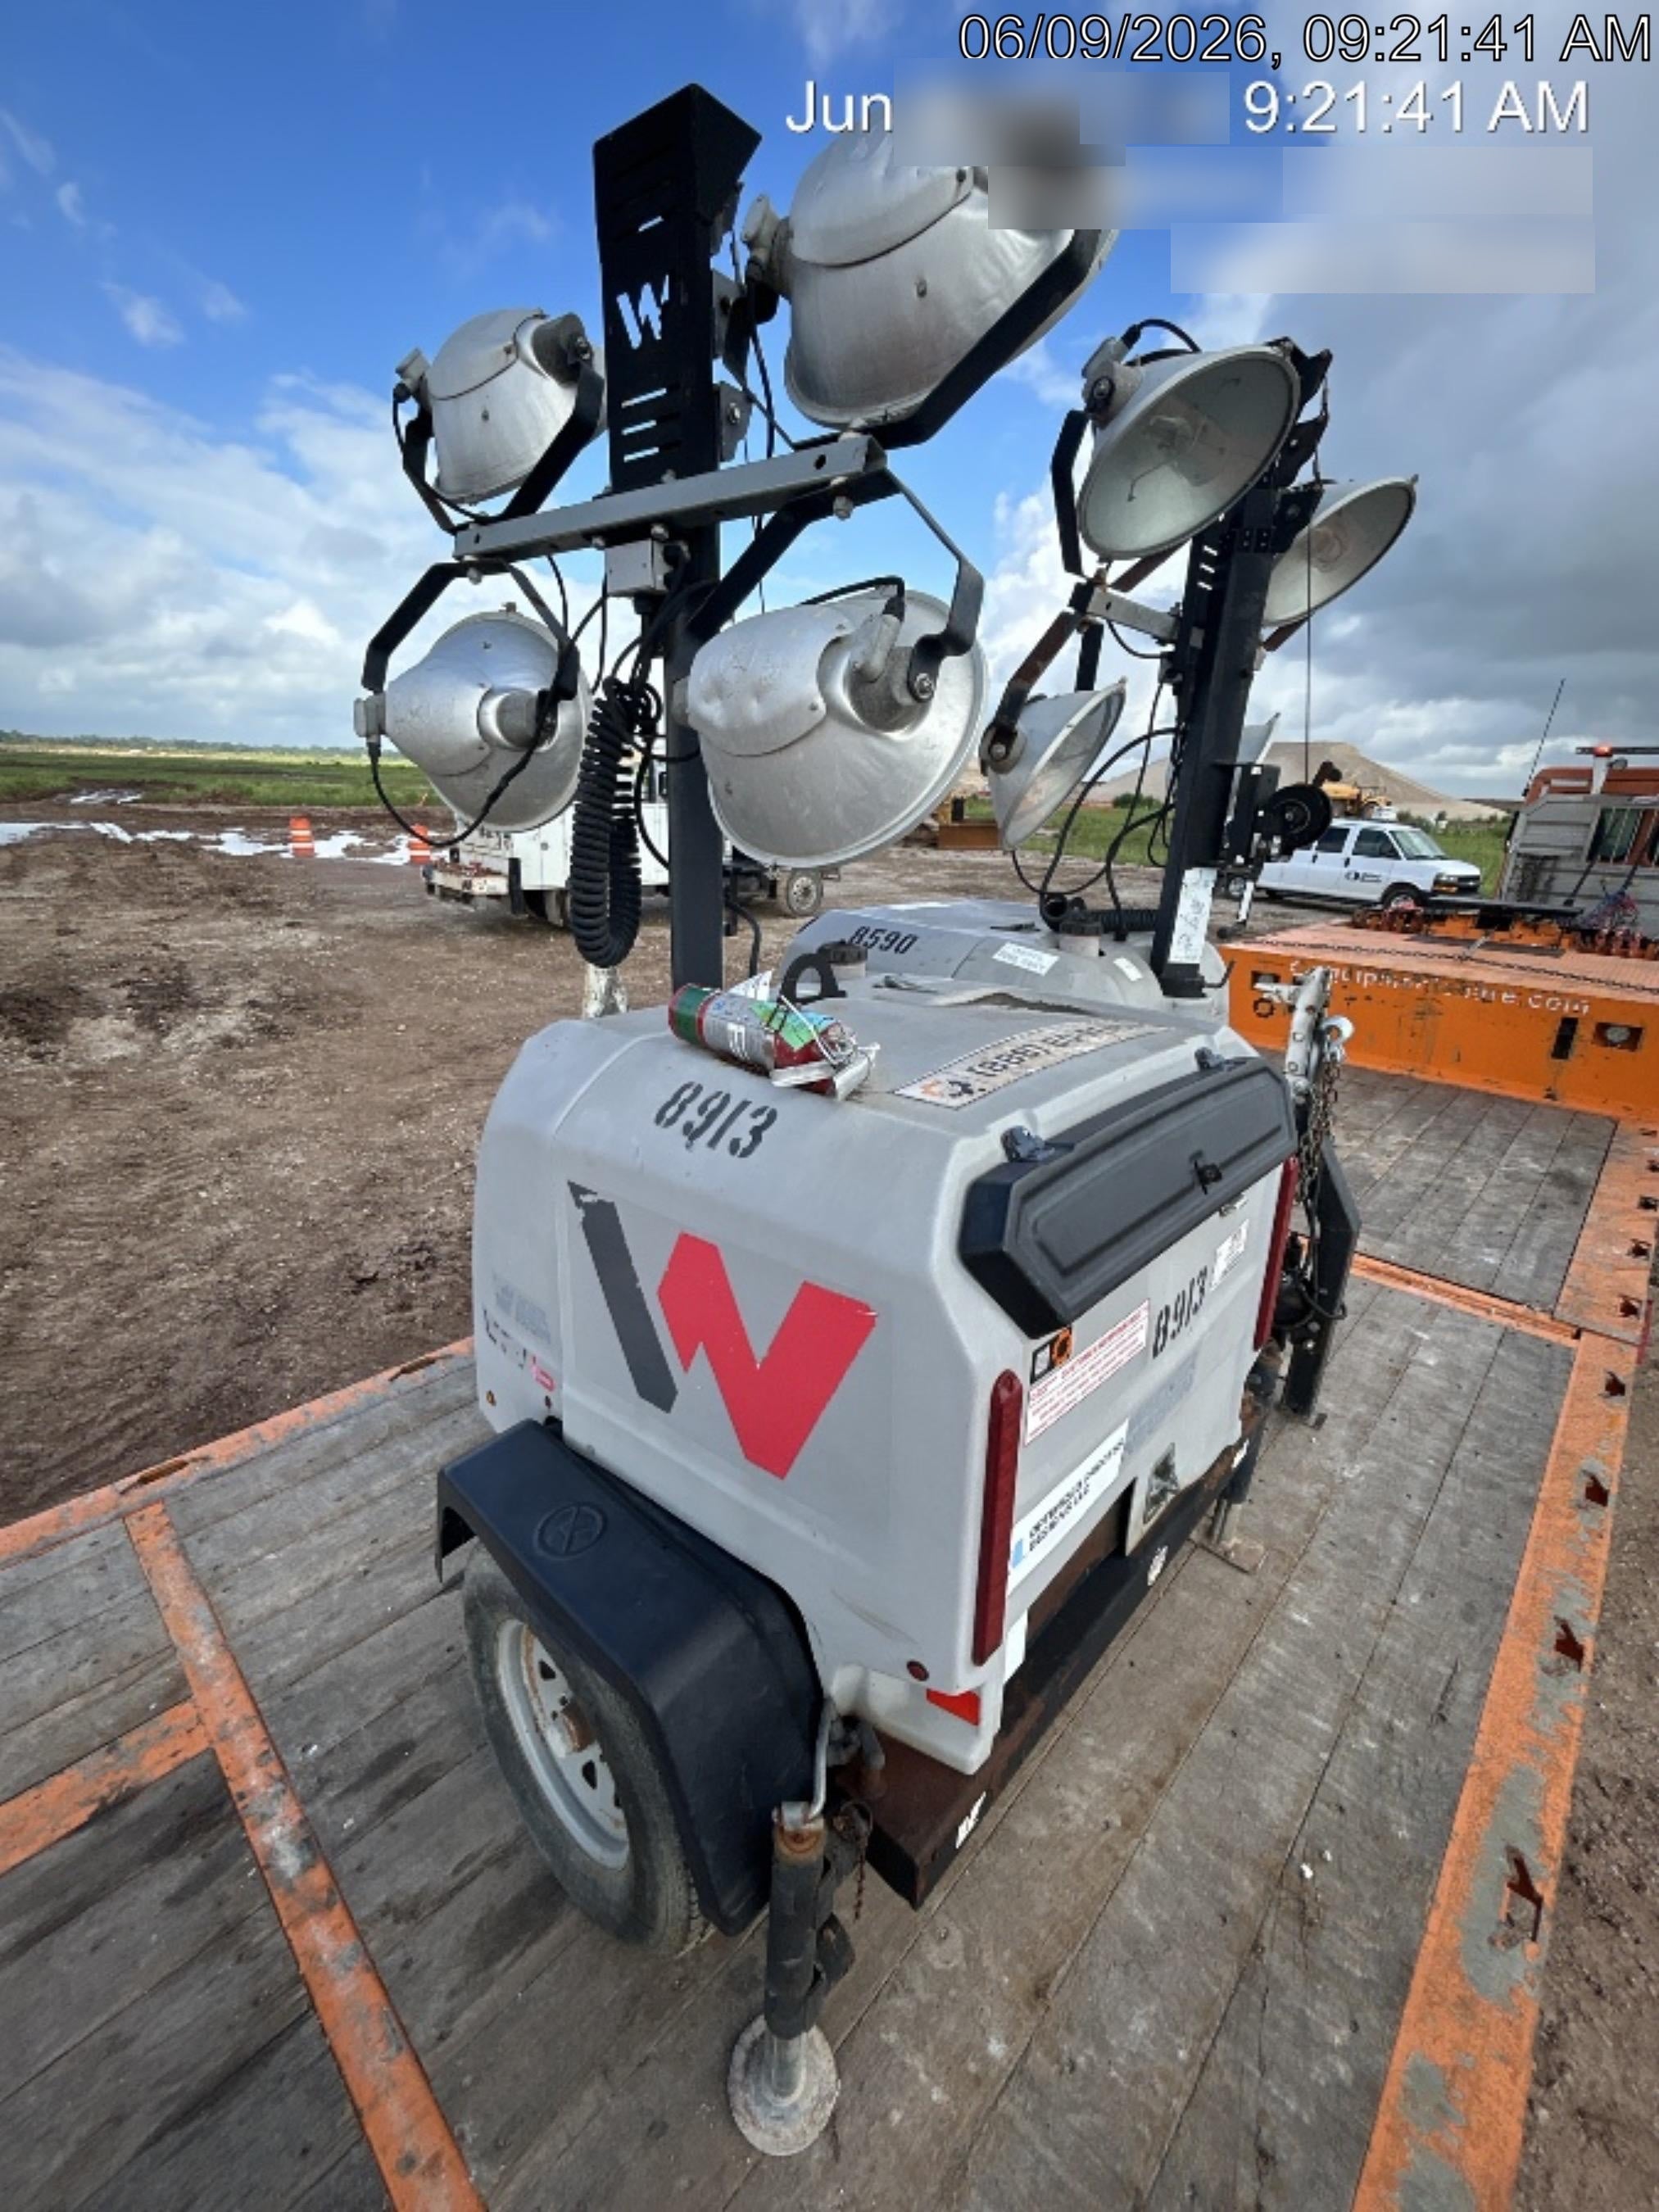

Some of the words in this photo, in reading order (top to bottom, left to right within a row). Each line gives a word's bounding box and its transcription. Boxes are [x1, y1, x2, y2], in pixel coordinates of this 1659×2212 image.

[849, 925, 919, 954] 8590
[654, 1081, 777, 1158] 8913
[1153, 1264, 1208, 1359] 8913
